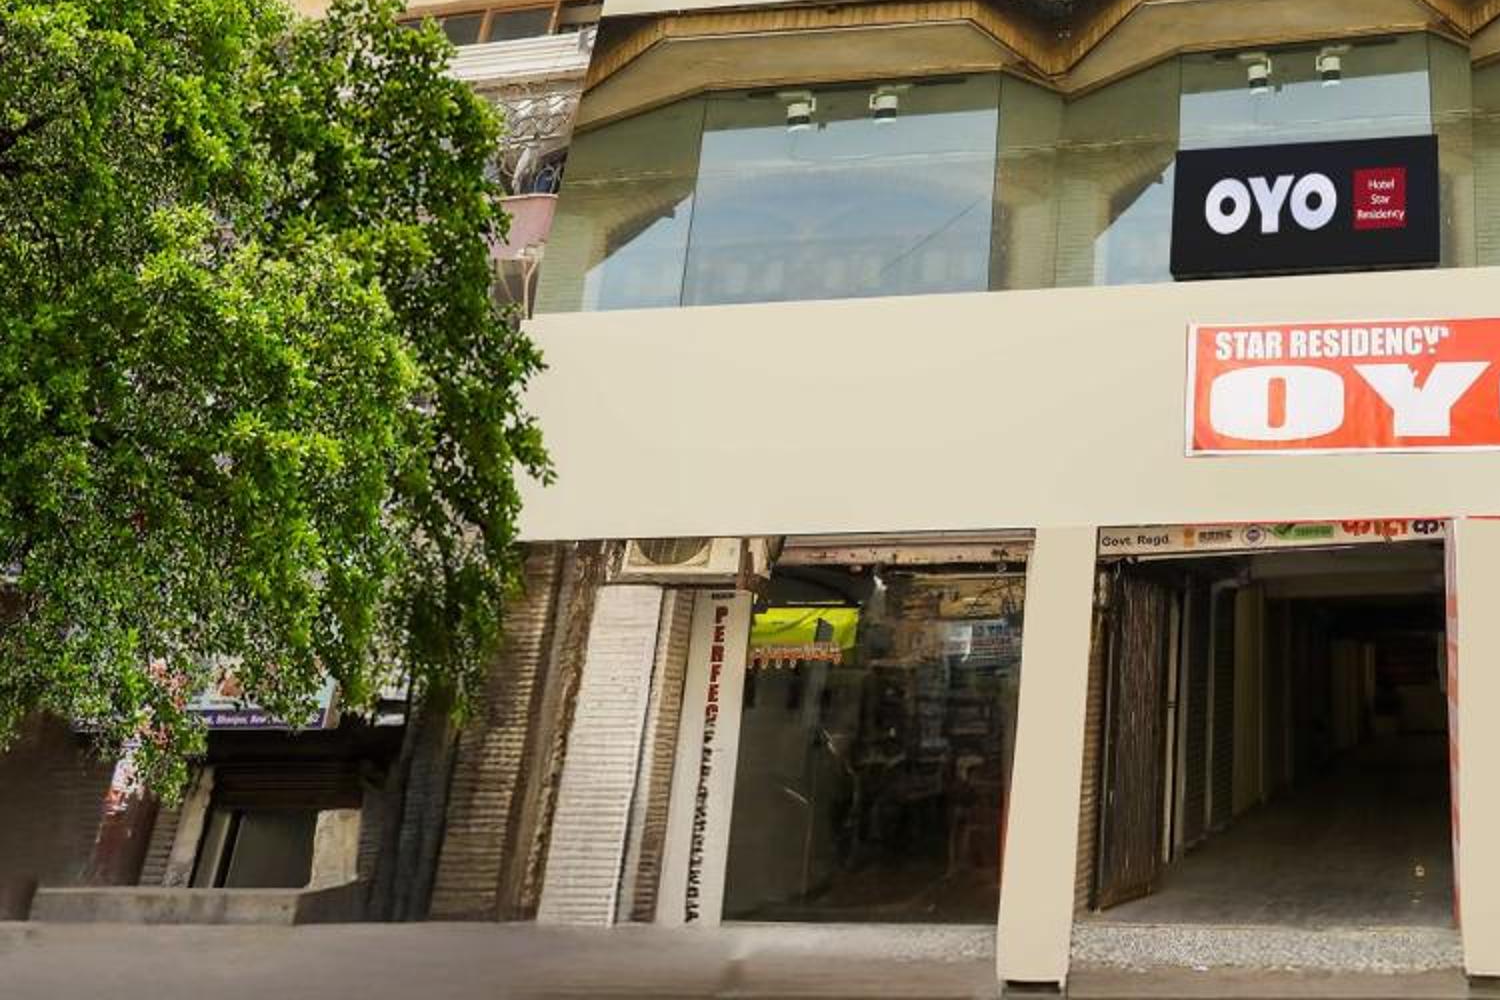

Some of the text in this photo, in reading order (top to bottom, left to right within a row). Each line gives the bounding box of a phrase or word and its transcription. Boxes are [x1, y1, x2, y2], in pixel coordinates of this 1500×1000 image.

[1367, 177, 1395, 190] Hotel
[1204, 171, 1337, 236] OYO
[1370, 193, 1391, 205] Star
[1356, 208, 1405, 221] Residency
[1215, 330, 1283, 361] STAR
